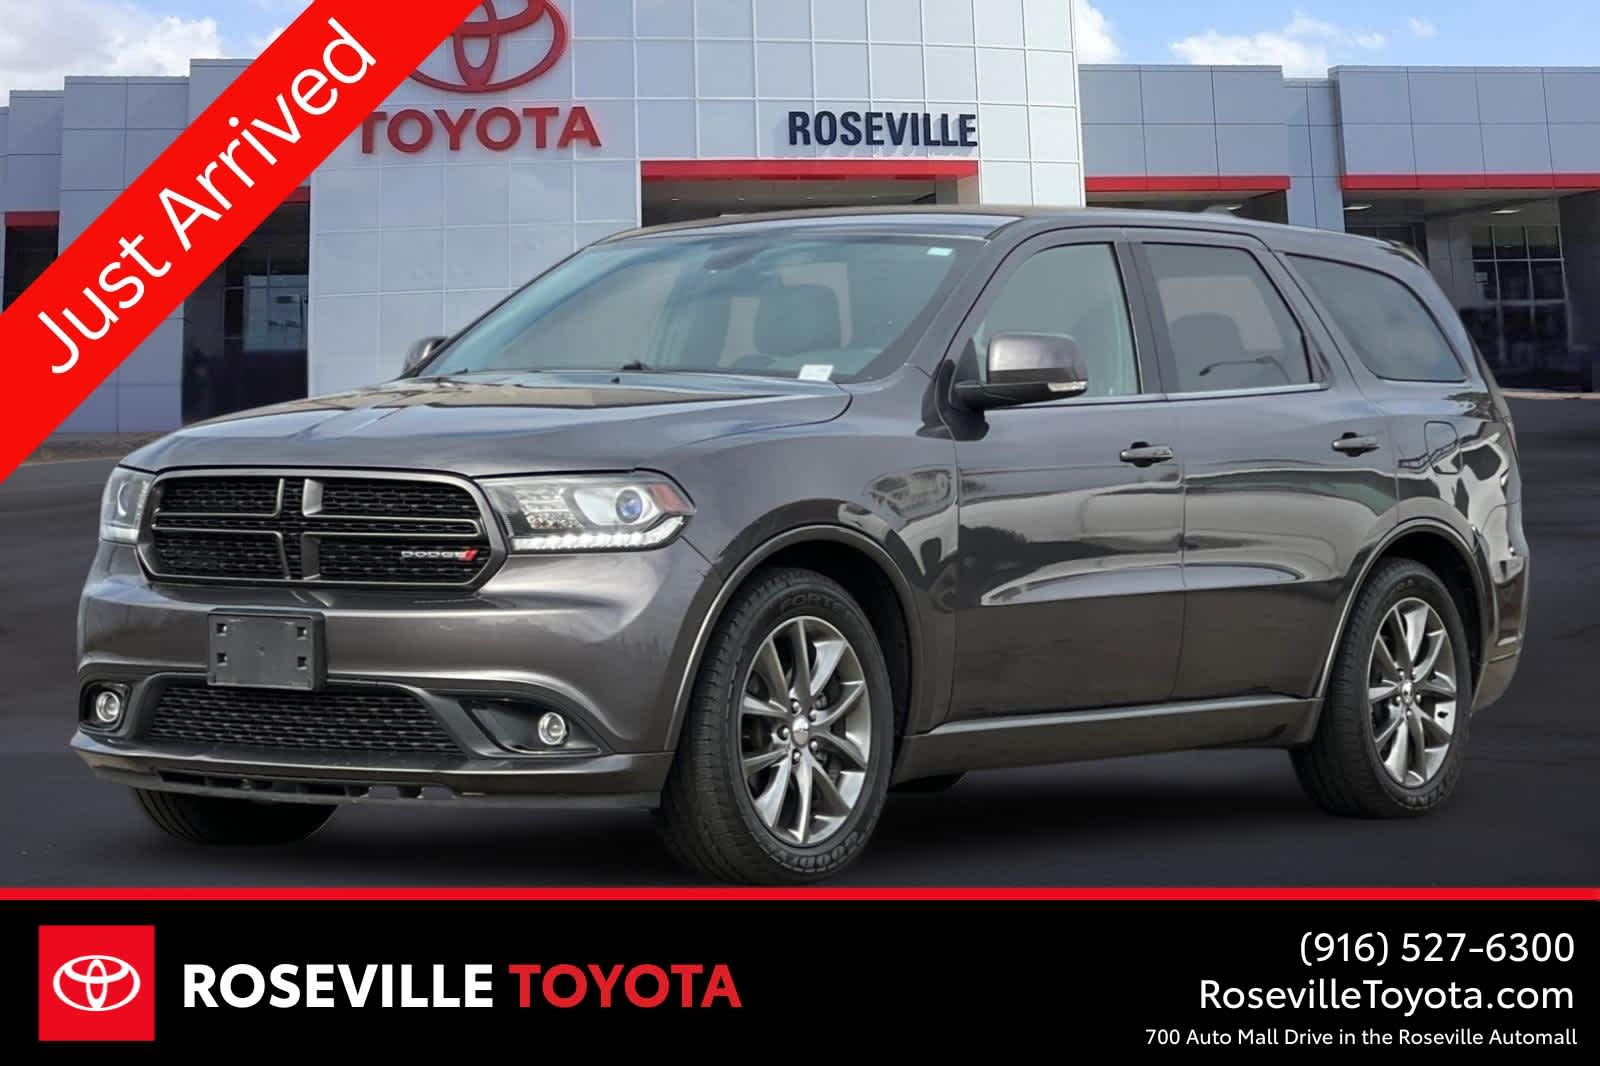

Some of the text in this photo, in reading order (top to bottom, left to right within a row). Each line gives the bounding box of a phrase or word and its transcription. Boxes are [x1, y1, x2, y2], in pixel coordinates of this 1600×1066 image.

[362, 106, 602, 154] TOYOTA
[788, 111, 978, 147] ROSEVILLE
[401, 550, 467, 558] DODGE
